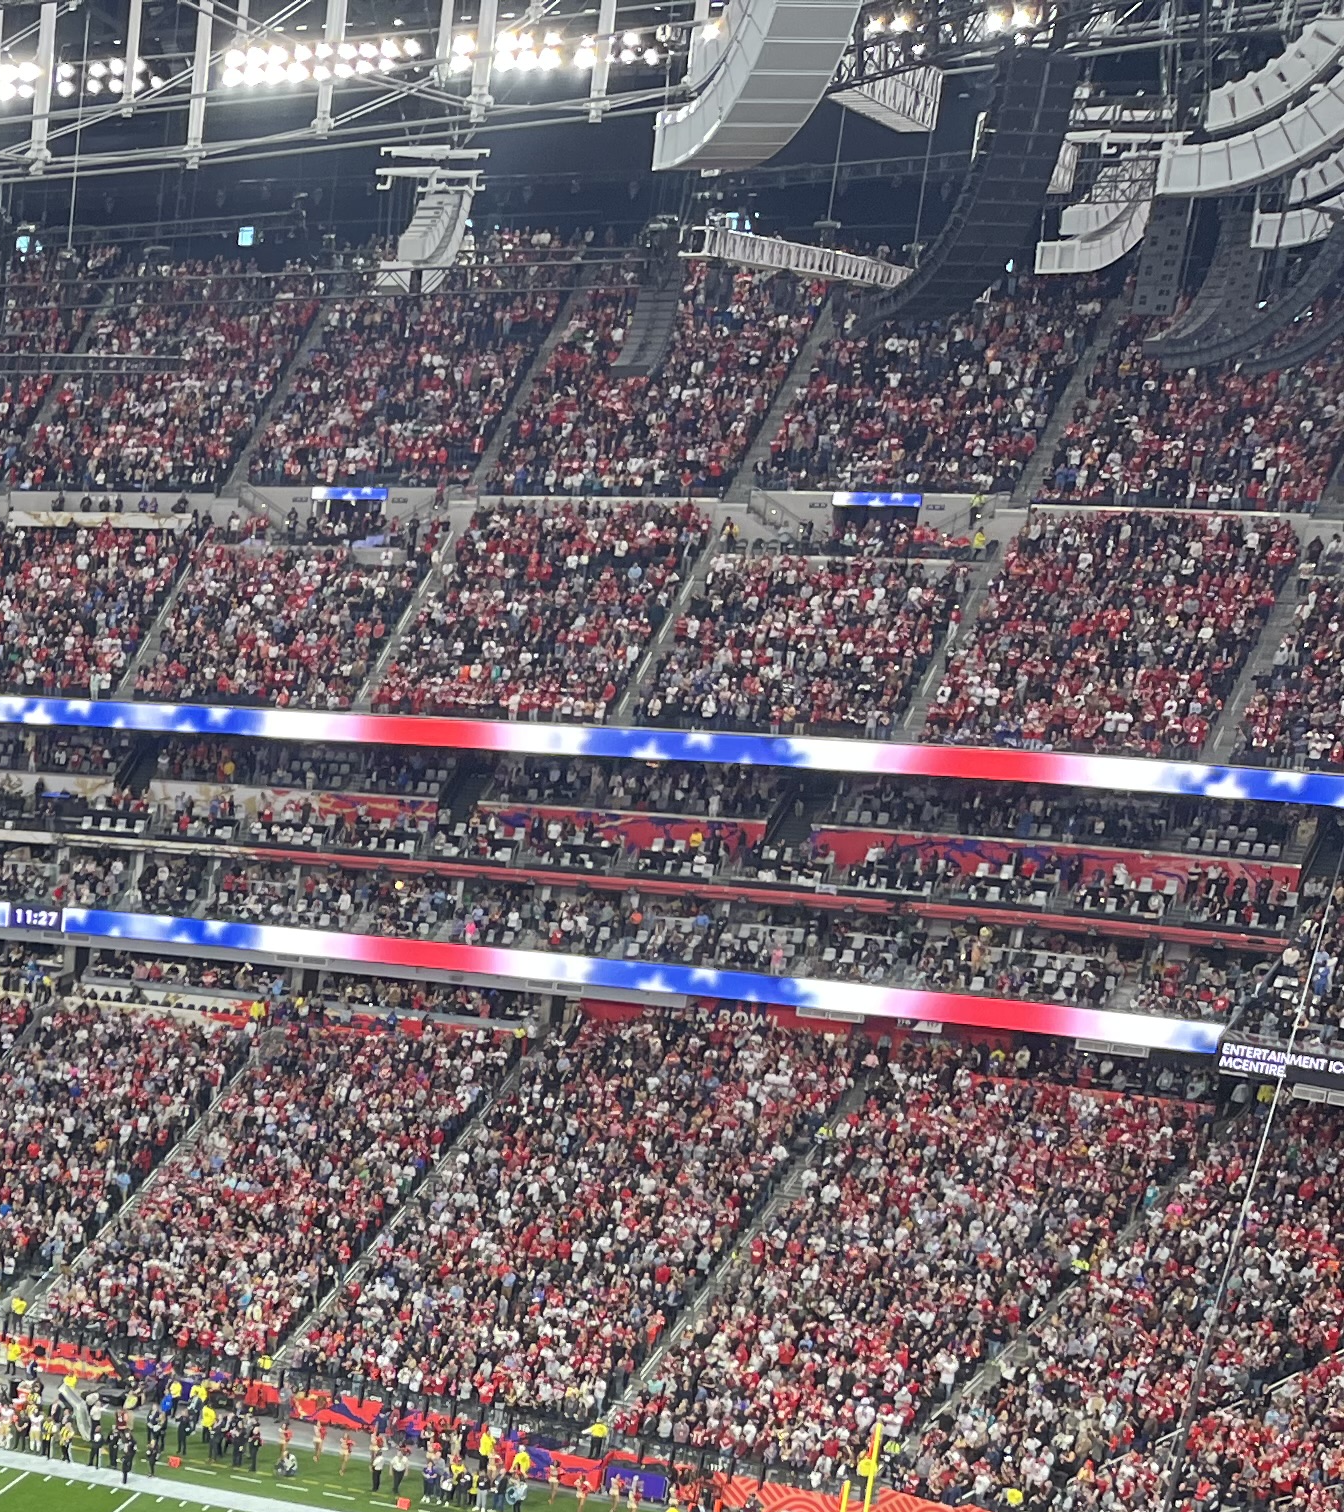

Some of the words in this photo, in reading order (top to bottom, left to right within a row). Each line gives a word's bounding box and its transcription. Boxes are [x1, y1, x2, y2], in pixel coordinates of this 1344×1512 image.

[15, 908, 58, 926] 11:27
[1221, 1042, 1328, 1071] ENTERTAINMENT
[1328, 1060, 1344, 1075] IC
